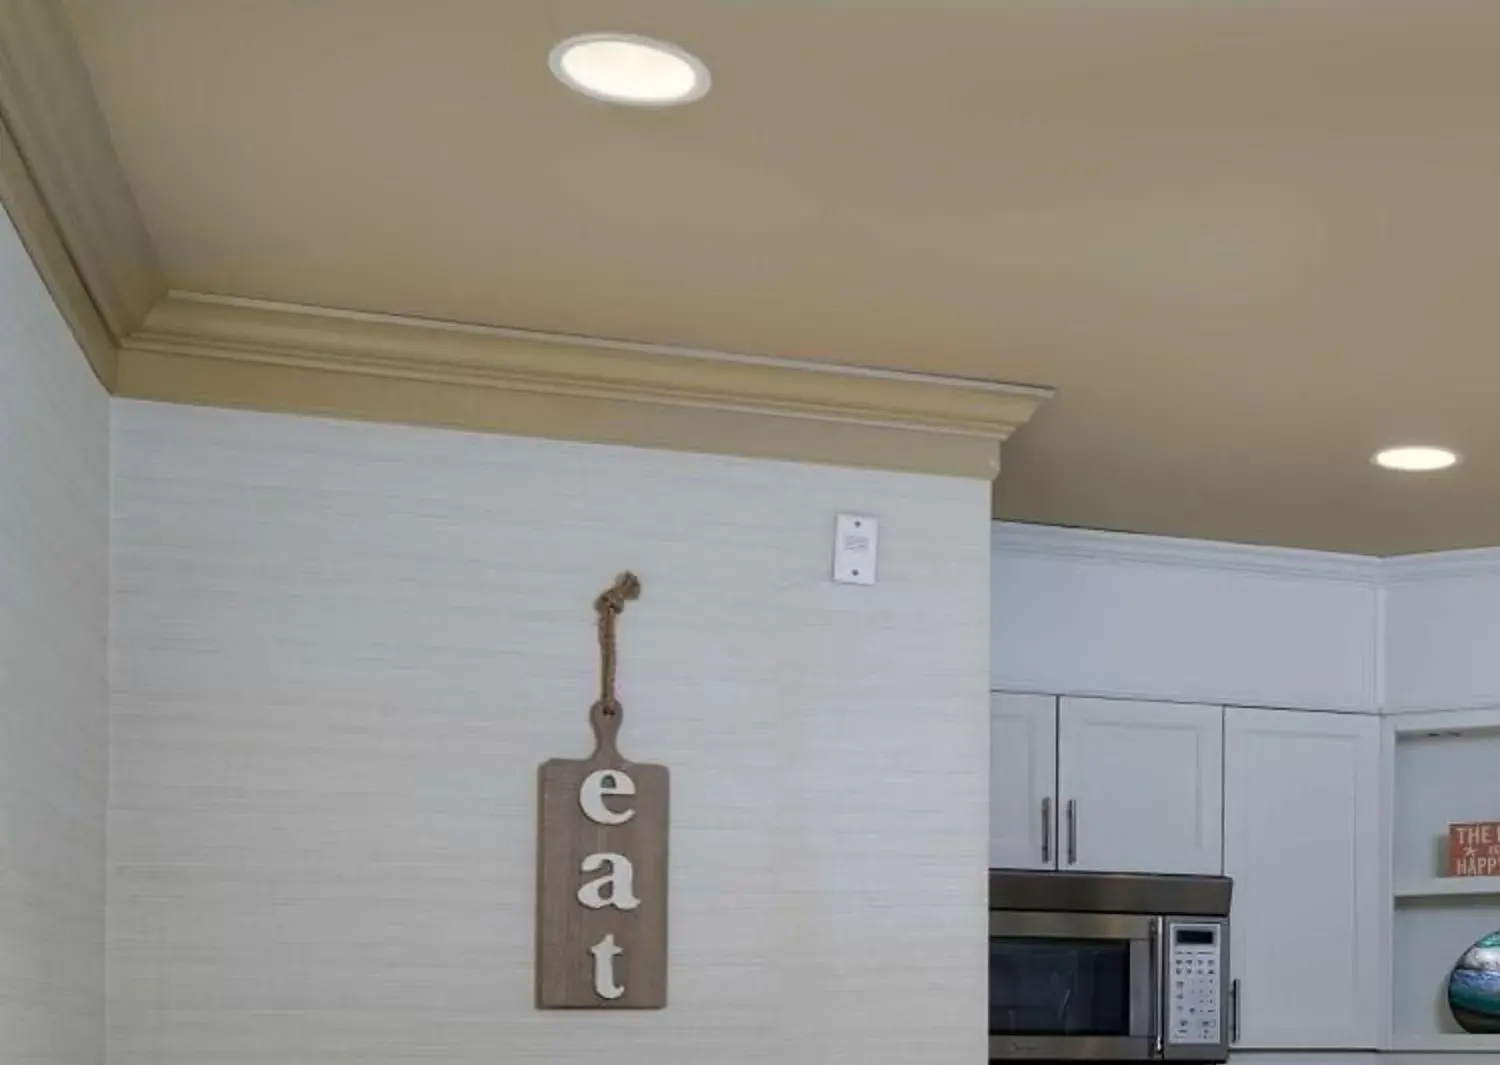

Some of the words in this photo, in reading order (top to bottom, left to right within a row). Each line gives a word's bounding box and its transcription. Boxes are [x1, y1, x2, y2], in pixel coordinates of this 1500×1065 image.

[1456, 827, 1492, 845] THE
[1488, 845, 1500, 855] IS
[577, 768, 641, 999] eat
